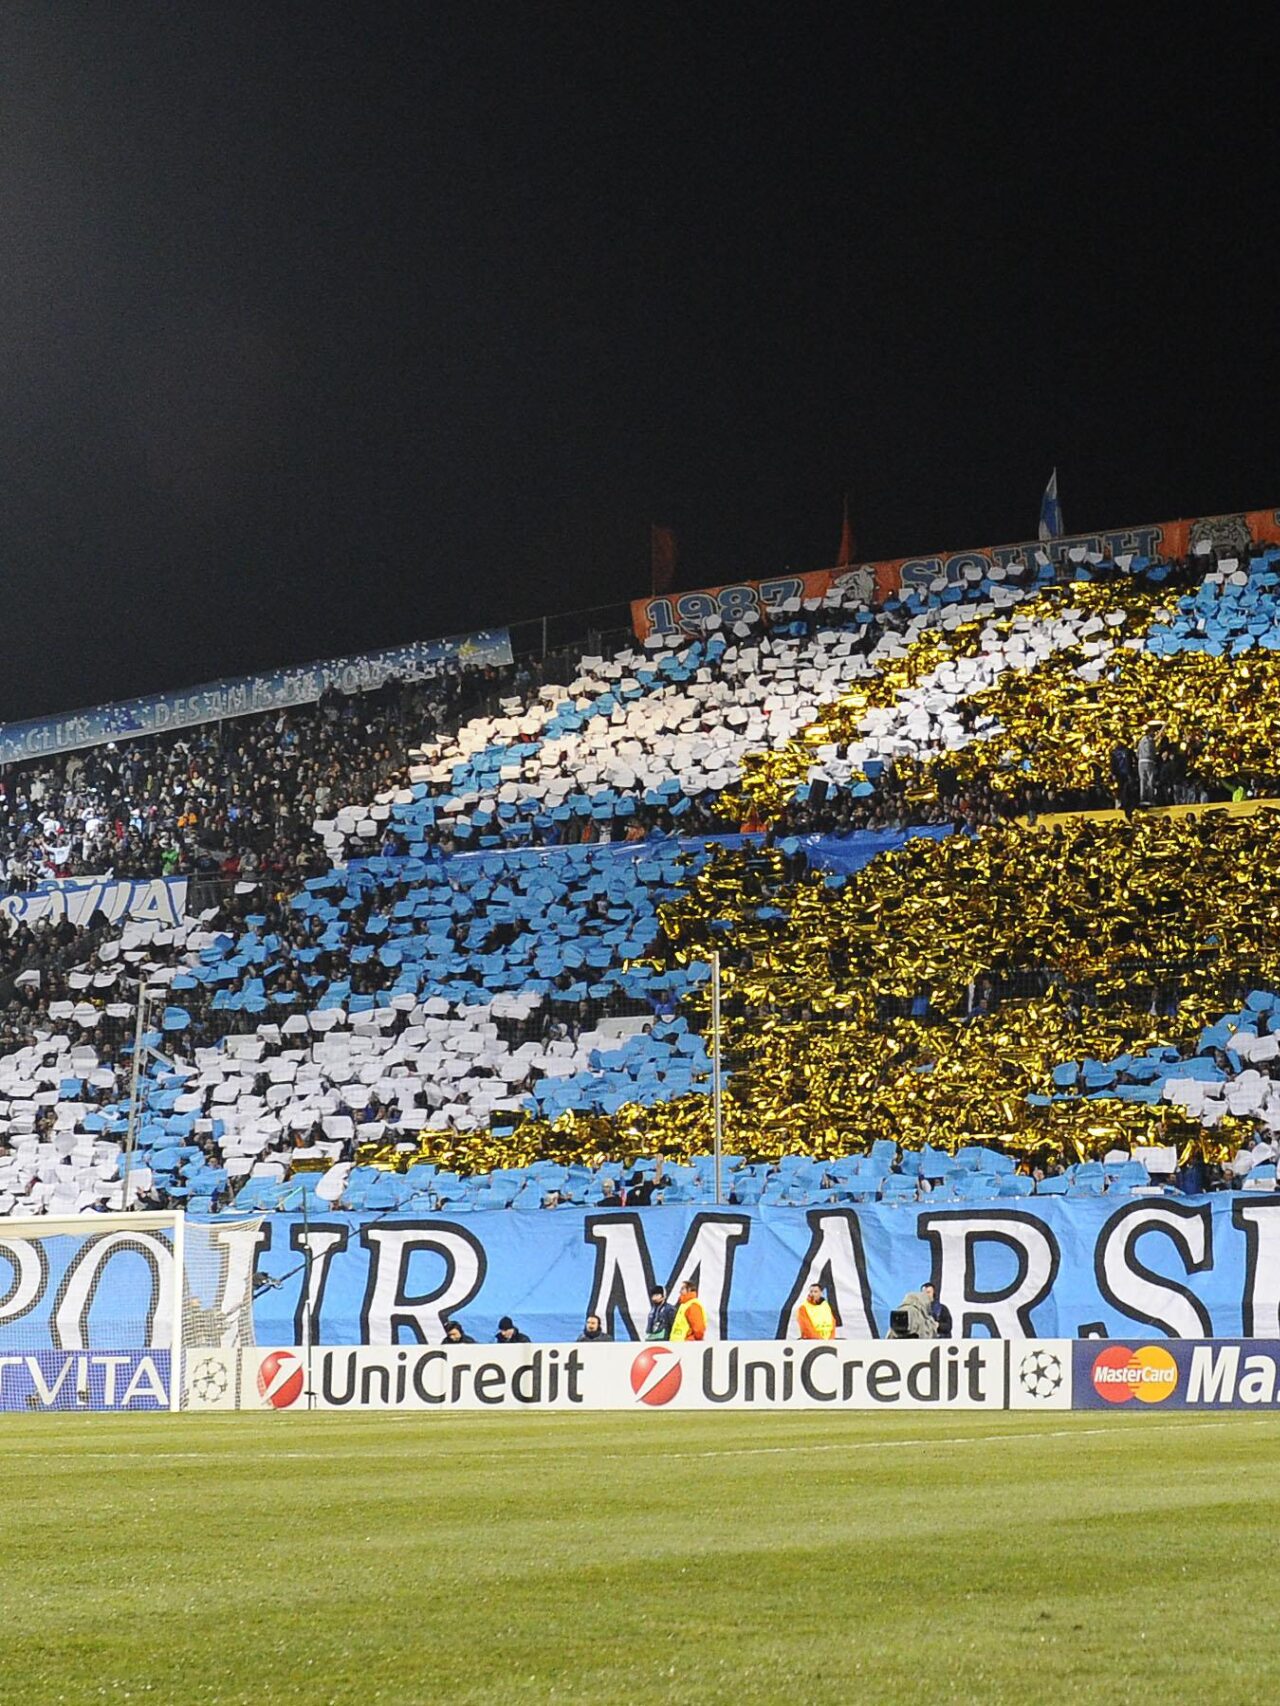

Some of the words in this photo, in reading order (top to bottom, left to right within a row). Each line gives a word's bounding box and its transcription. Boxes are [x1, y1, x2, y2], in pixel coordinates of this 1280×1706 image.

[646, 578, 803, 637] 1987
[322, 1349, 585, 1403] UniCredit
[702, 1345, 987, 1402] UniCredit
[1094, 1366, 1174, 1383] MasterCard
